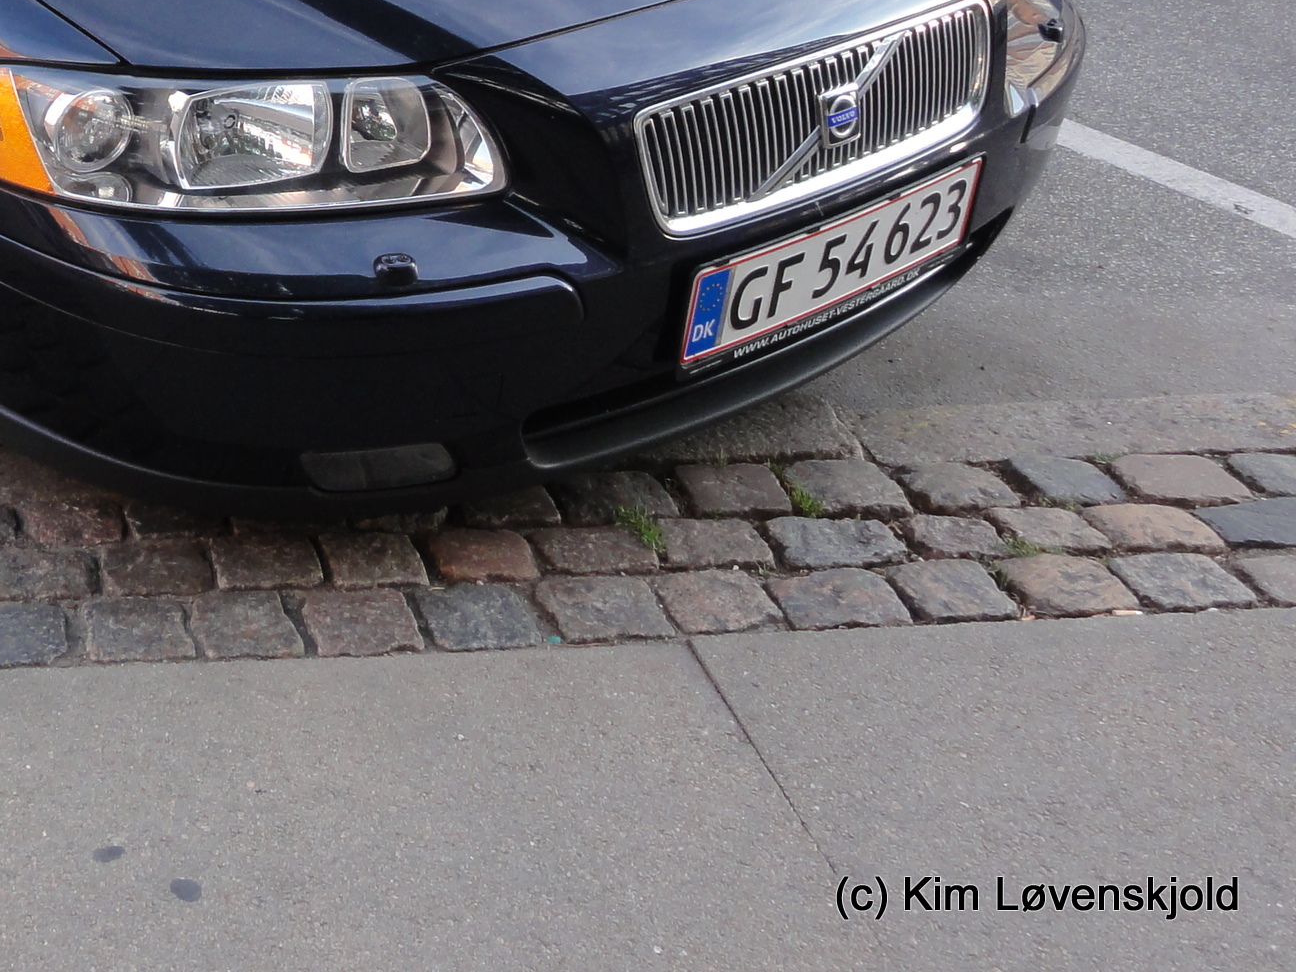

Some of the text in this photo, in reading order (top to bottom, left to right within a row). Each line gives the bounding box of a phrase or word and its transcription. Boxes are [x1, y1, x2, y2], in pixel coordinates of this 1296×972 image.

[731, 179, 968, 331] GF 54 623
[692, 319, 716, 343] DK
